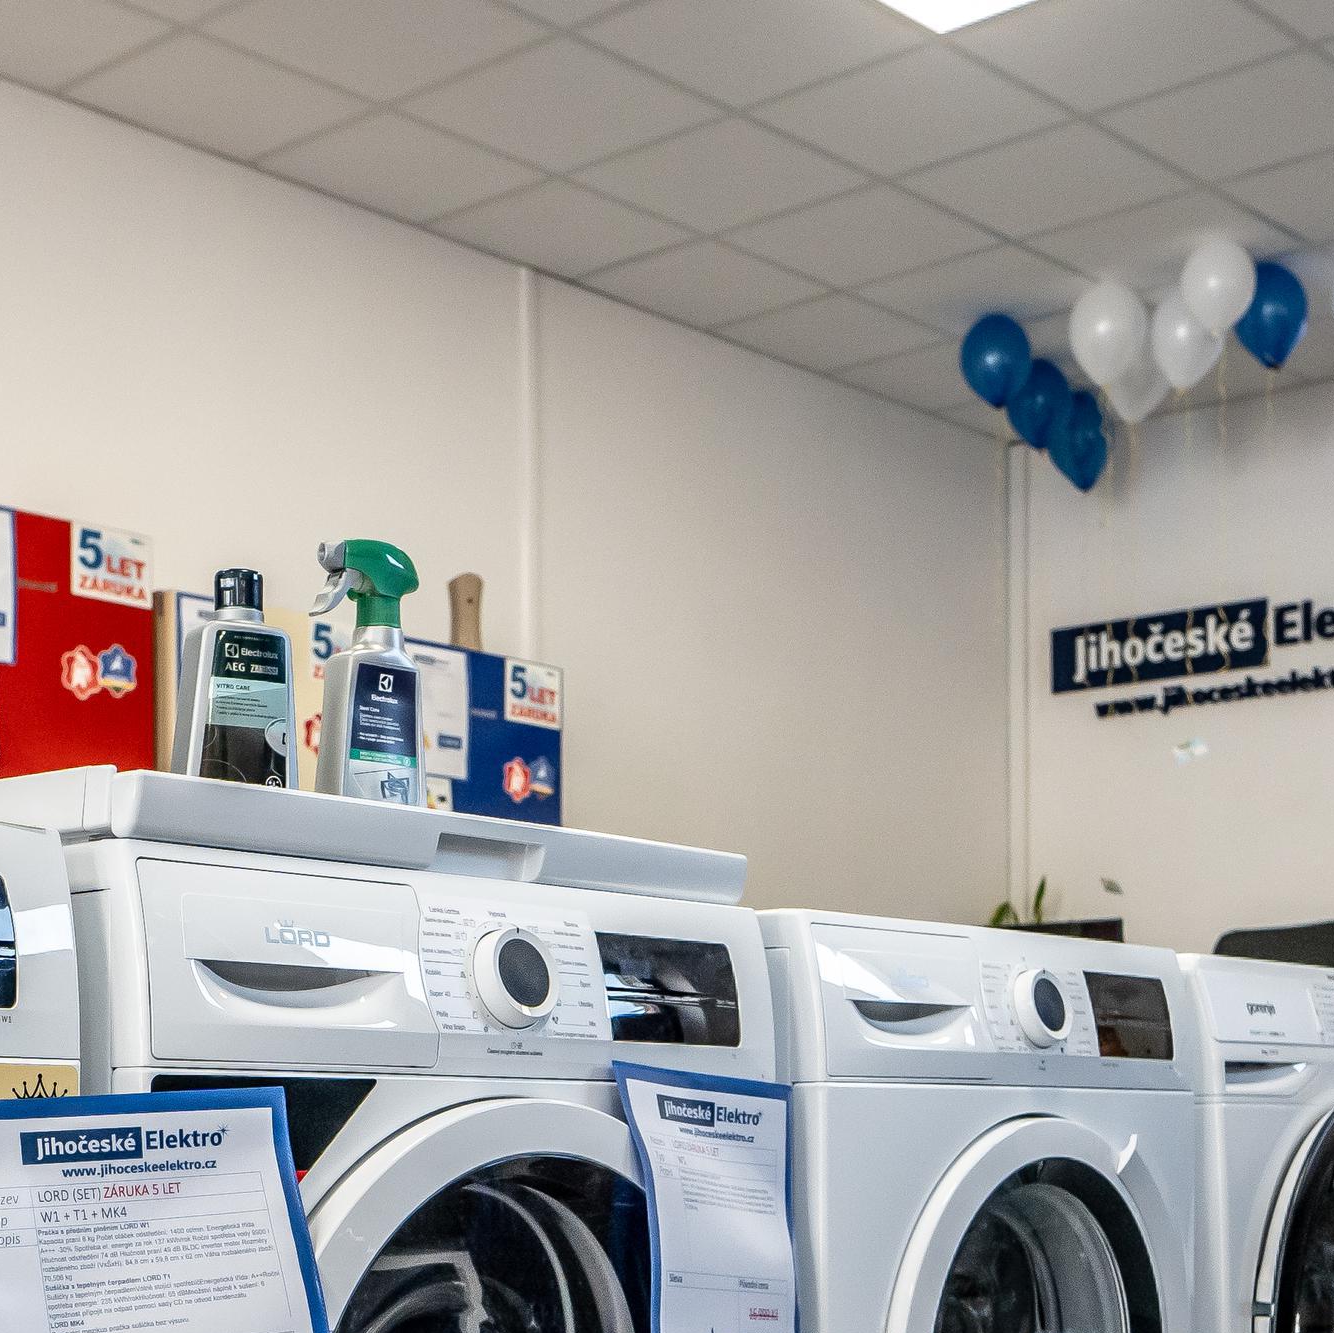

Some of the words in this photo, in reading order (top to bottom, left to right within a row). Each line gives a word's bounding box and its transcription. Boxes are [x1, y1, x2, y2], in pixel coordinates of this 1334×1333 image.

[79, 528, 103, 570] 5
[107, 554, 147, 582] LET
[241, 648, 279, 660] Electrolux
[1072, 613, 1255, 684] Jihočeské
[225, 662, 246, 672] AEG
[509, 666, 527, 701] 5
[264, 926, 331, 948] LORD
[665, 1100, 711, 1121] Jihočeské
[717, 1106, 759, 1126] Elektro
[37, 1131, 136, 1160] Jihočeské
[146, 1128, 223, 1150] Elektro
[62, 1159, 217, 1178] www.jihoceskeelektro.cz
[38, 1190, 68, 1203] LORD
[73, 1187, 101, 1203] (SET)
[103, 1183, 149, 1199] ZÁRUKA
[152, 1184, 159, 1195] 5
[163, 1182, 181, 1195] LET
[40, 1210, 59, 1224] W1
[73, 1208, 88, 1222] T1
[101, 1206, 127, 1220] MK4
[143, 1274, 161, 1282] LORD
[51, 1320, 68, 1329] LORD
